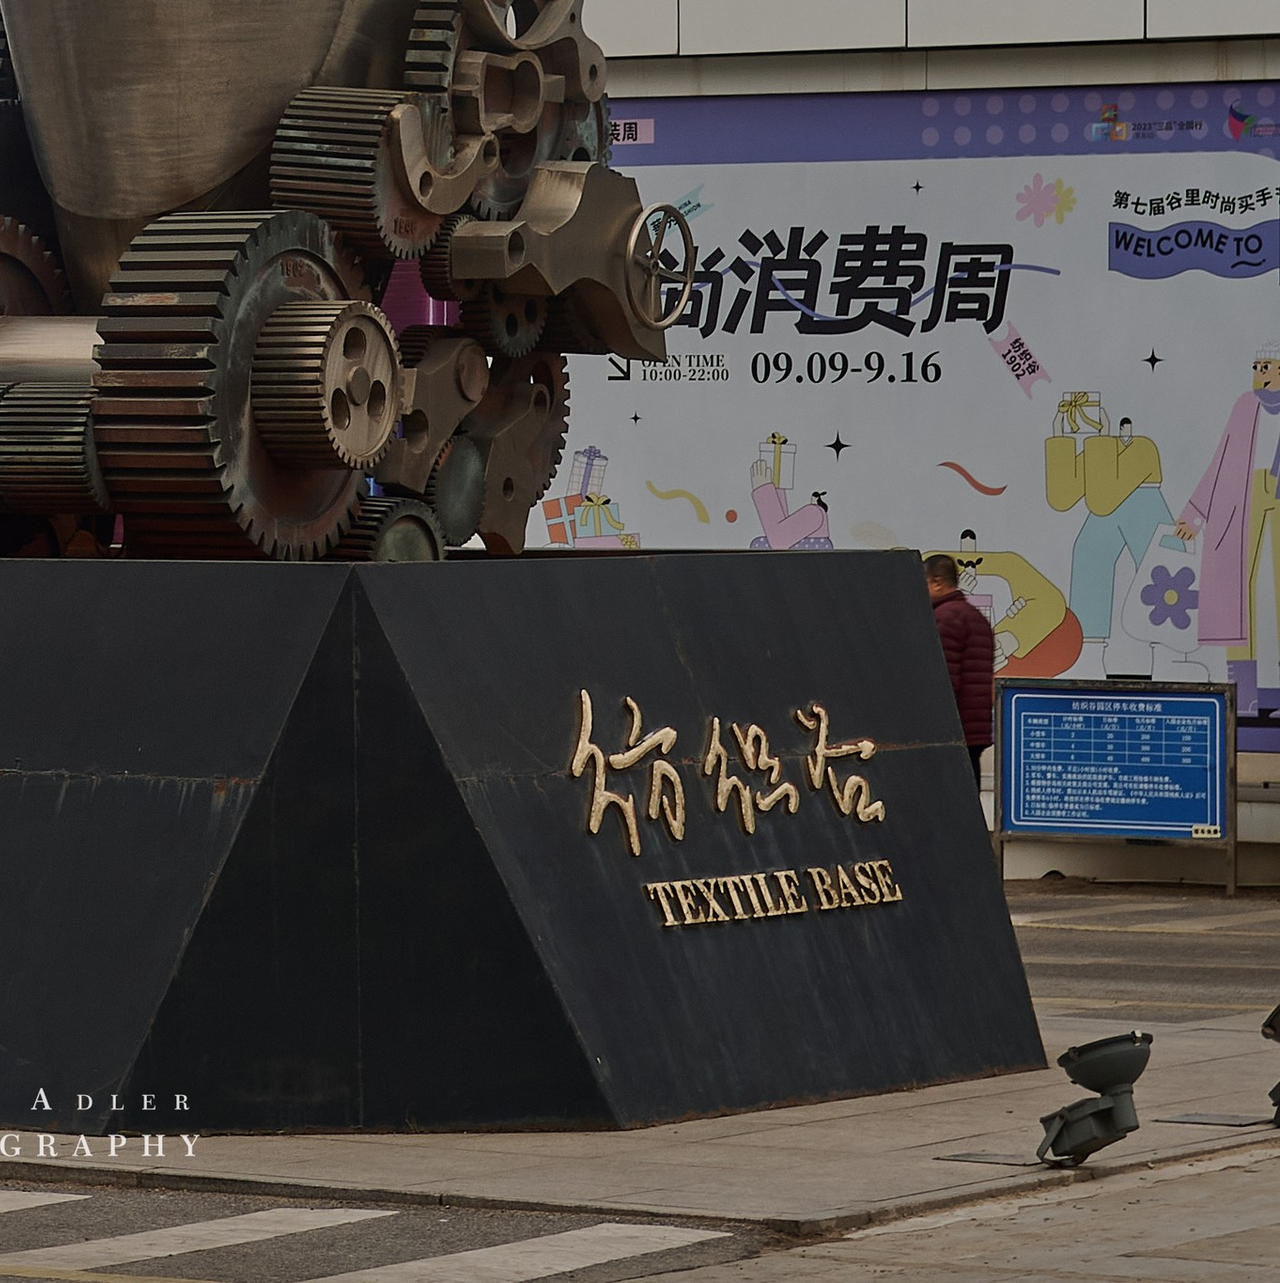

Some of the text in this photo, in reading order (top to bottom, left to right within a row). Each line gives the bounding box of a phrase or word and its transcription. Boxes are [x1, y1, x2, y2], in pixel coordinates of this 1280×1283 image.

[1114, 228, 1263, 258] WELCOME TO
[685, 354, 725, 368] TIME
[751, 350, 943, 384] 09.09-9.16
[1002, 349, 1026, 381] 1902
[1010, 337, 1040, 376] 纺织谷
[642, 368, 730, 382] 10:00-22:00
[646, 858, 904, 927] TEXTILE BASE
